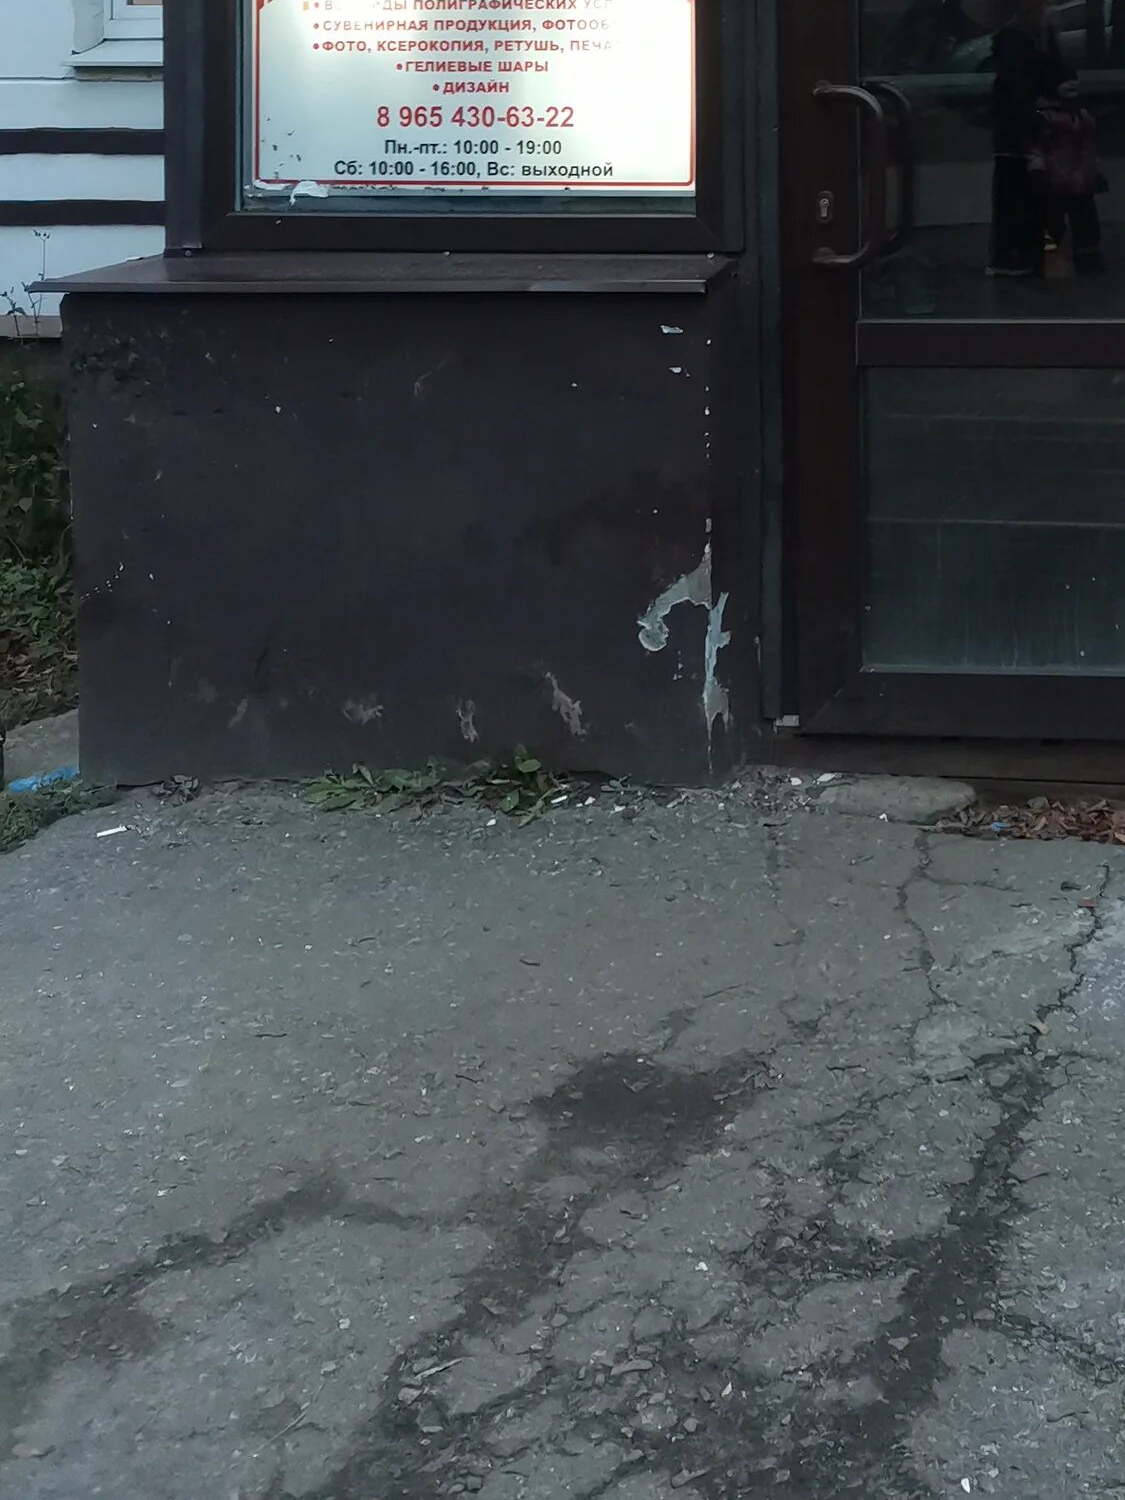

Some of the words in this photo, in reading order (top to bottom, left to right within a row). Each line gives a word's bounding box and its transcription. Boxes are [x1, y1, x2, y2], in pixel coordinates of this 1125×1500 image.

[322, 19, 428, 32] СУВЕНИРНАЯ
[434, 19, 537, 33] ПРОДУКЦИЯ,
[322, 39, 373, 54] ФОТО,
[377, 39, 490, 54] КСЕРОКОПИЯ,
[494, 39, 565, 54] РЕТУШЬ,
[405, 60, 493, 73] ГЕЛИЕВЫЕ
[498, 60, 549, 73] ШАРЫ
[443, 79, 510, 95] ДИЗАЙН
[376, 106, 390, 128] 8
[399, 106, 443, 128] 965
[451, 106, 575, 128] 430-63-22
[384, 139, 446, 155] Пн.-пт.:
[453, 140, 499, 155] 10:00
[516, 139, 562, 155] 19:00
[334, 160, 363, 176] Сб:
[369, 161, 414, 176] 10:00
[432, 161, 481, 178] 16:00,
[487, 161, 515, 176] Вс:
[521, 161, 613, 178] выходной
